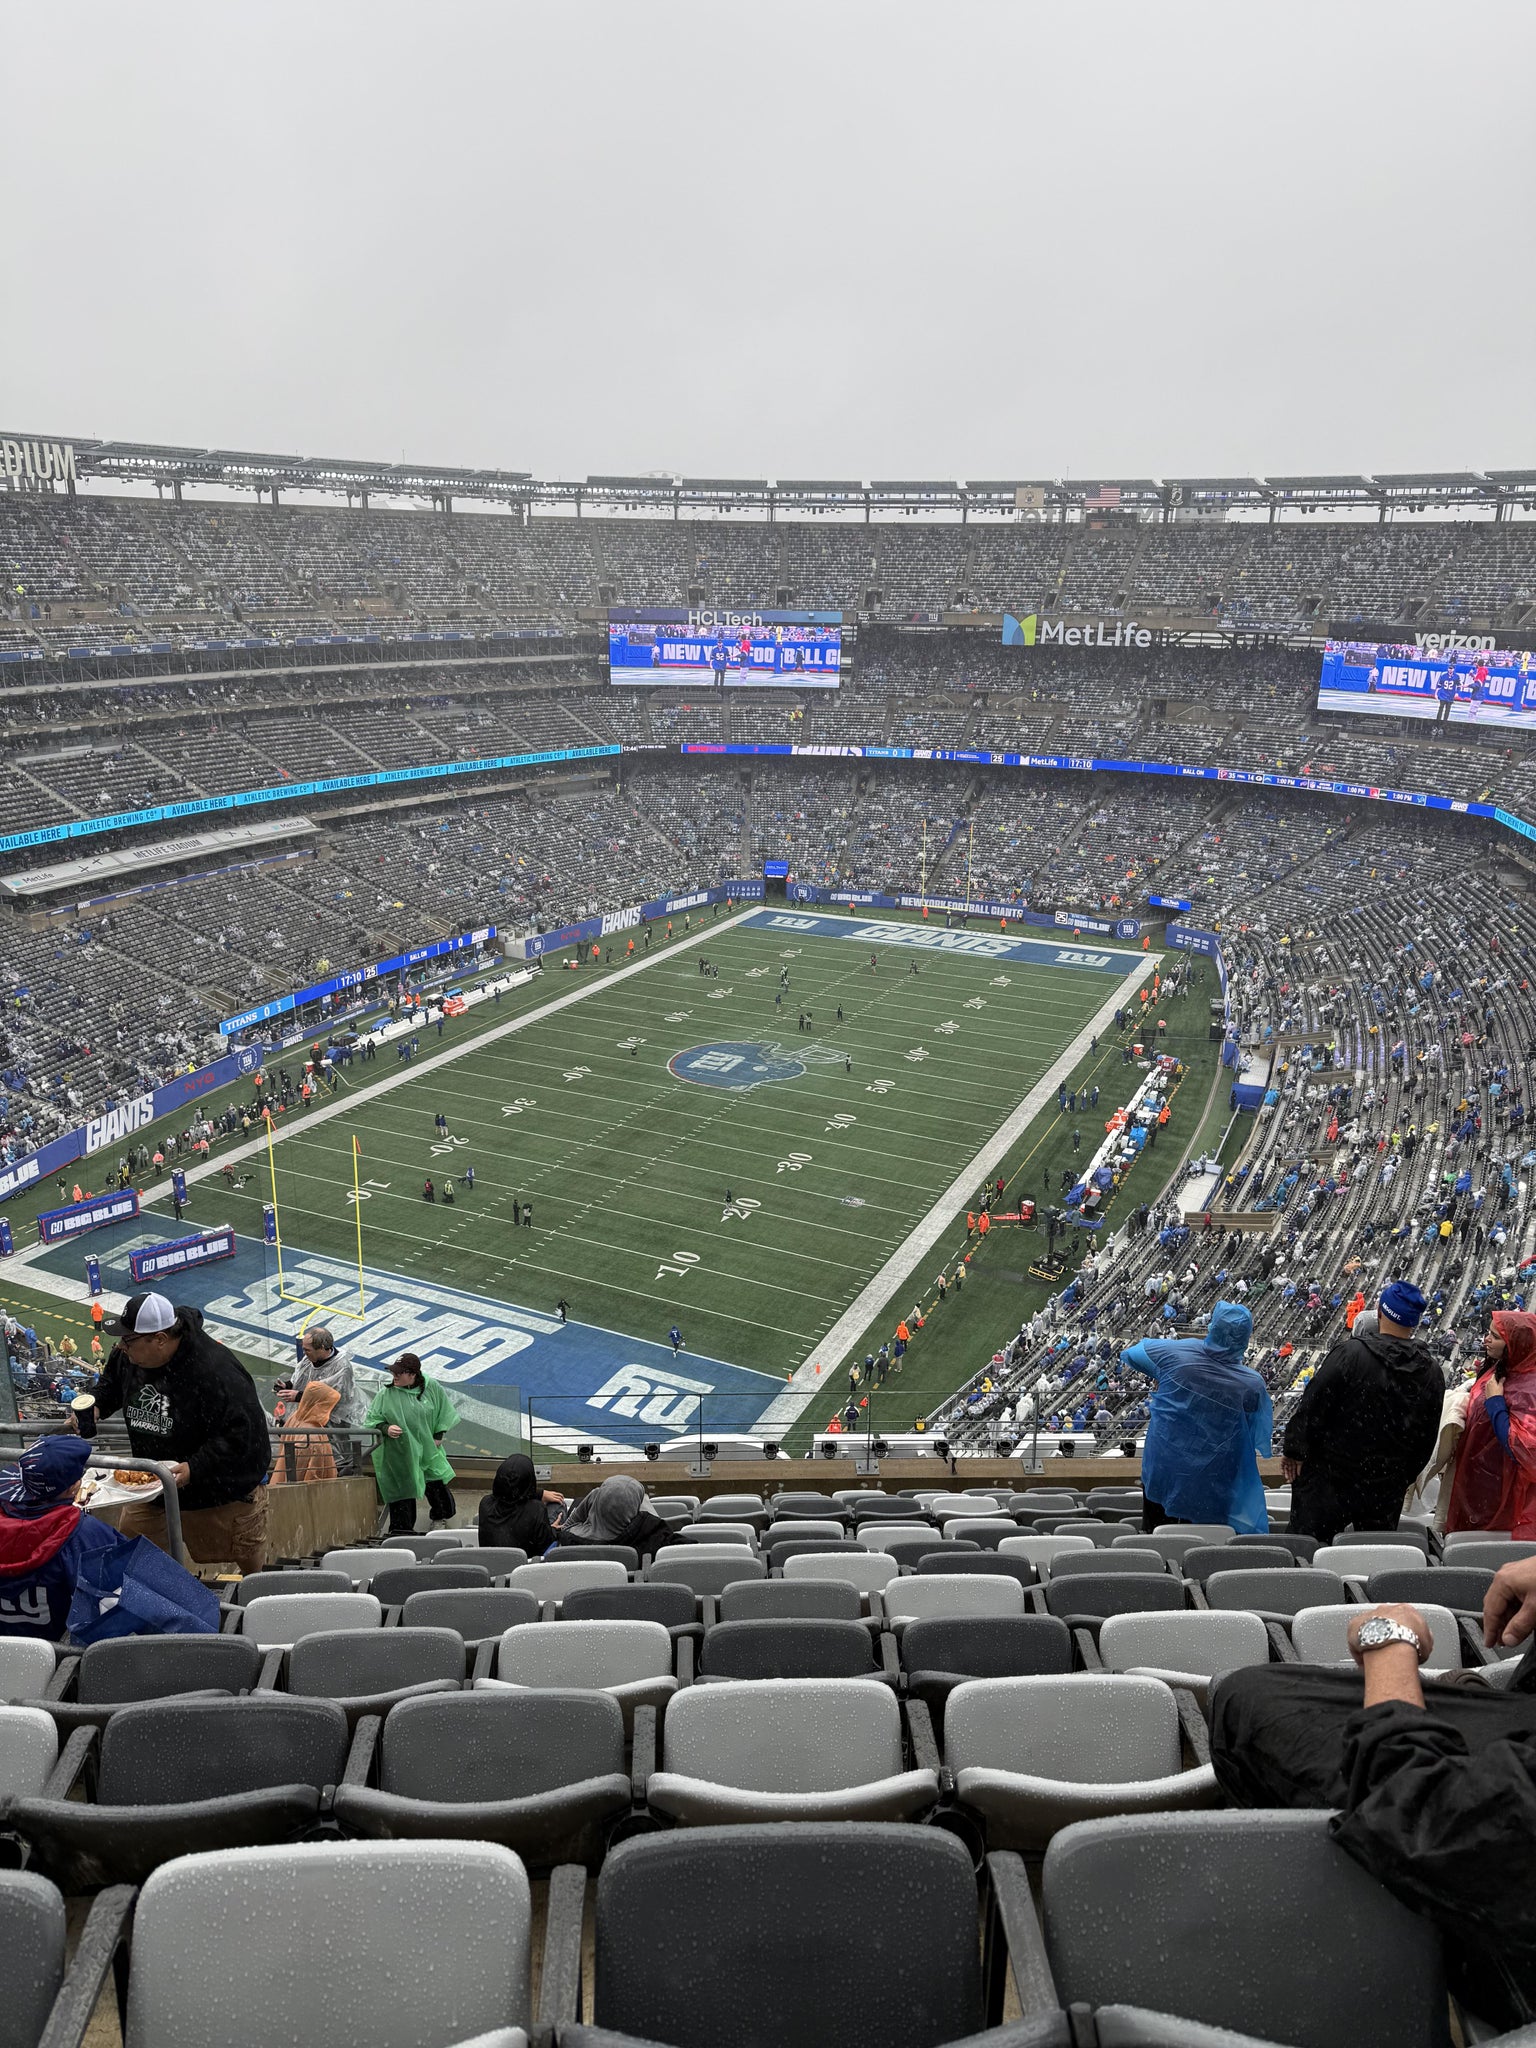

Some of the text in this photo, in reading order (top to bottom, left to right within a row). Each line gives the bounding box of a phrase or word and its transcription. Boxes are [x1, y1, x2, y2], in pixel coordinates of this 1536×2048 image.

[688, 611, 762, 626] HCLTech
[1040, 620, 1152, 648] MetLife
[1415, 629, 1496, 651] verizon
[663, 643, 701, 660] NEW
[1381, 666, 1427, 689] NEW
[1444, 680, 1454, 690] 92
[454, 759, 498, 772] AVAILABLE HERE
[992, 755, 1003, 763] 25
[1030, 757, 1058, 767] MetLife
[1070, 759, 1092, 769] 17:10
[322, 775, 371, 790] AVAILABLE HERE
[385, 770, 409, 781] ATHLETIC
[410, 767, 433, 778] BREWING
[1276, 777, 1287, 785] 1:00
[244, 790, 270, 803] ATHLETIC
[273, 786, 298, 799] BREWING
[1347, 786, 1366, 795] 1:00 PM
[1404, 794, 1412, 802] PM
[171, 797, 227, 816] AVAILABLE HERE
[80, 818, 111, 833] ATHLETIC
[113, 812, 144, 827] BREWING
[40, 828, 61, 842] HERE
[133, 839, 203, 860] METLIFE STADIUM
[22, 871, 55, 884] MetLife
[688, 892, 708, 907] BLUE
[901, 896, 1024, 918] NEW YORK FOOTBALL GIANTS
[602, 906, 642, 934] GIANTS
[852, 925, 1022, 955] GIANTS
[409, 950, 428, 962] BALL ON
[341, 971, 362, 987] 17:10
[366, 967, 376, 977] 25
[962, 996, 987, 1010] 20
[225, 1012, 258, 1031] TITANS
[264, 1006, 270, 1017] 0
[934, 1020, 960, 1035] 30
[282, 1033, 304, 1048] GIANTS
[903, 1046, 930, 1062] 40
[562, 1064, 593, 1081] 40
[865, 1079, 895, 1094] 50
[503, 1097, 537, 1114] 30
[86, 1093, 154, 1154] GIANTS
[828, 1111, 857, 1131] 40
[433, 1134, 470, 1153] 20
[782, 1151, 813, 1172] 30
[0, 1158, 40, 1195] BLUE
[346, 1178, 391, 1203] 10
[731, 1197, 762, 1219] 20
[50, 1200, 133, 1235] GO BIG BLUE
[142, 1238, 229, 1274] GO BIG BLUE
[661, 1250, 702, 1277] 10
[203, 1265, 535, 1384] GIANTS
